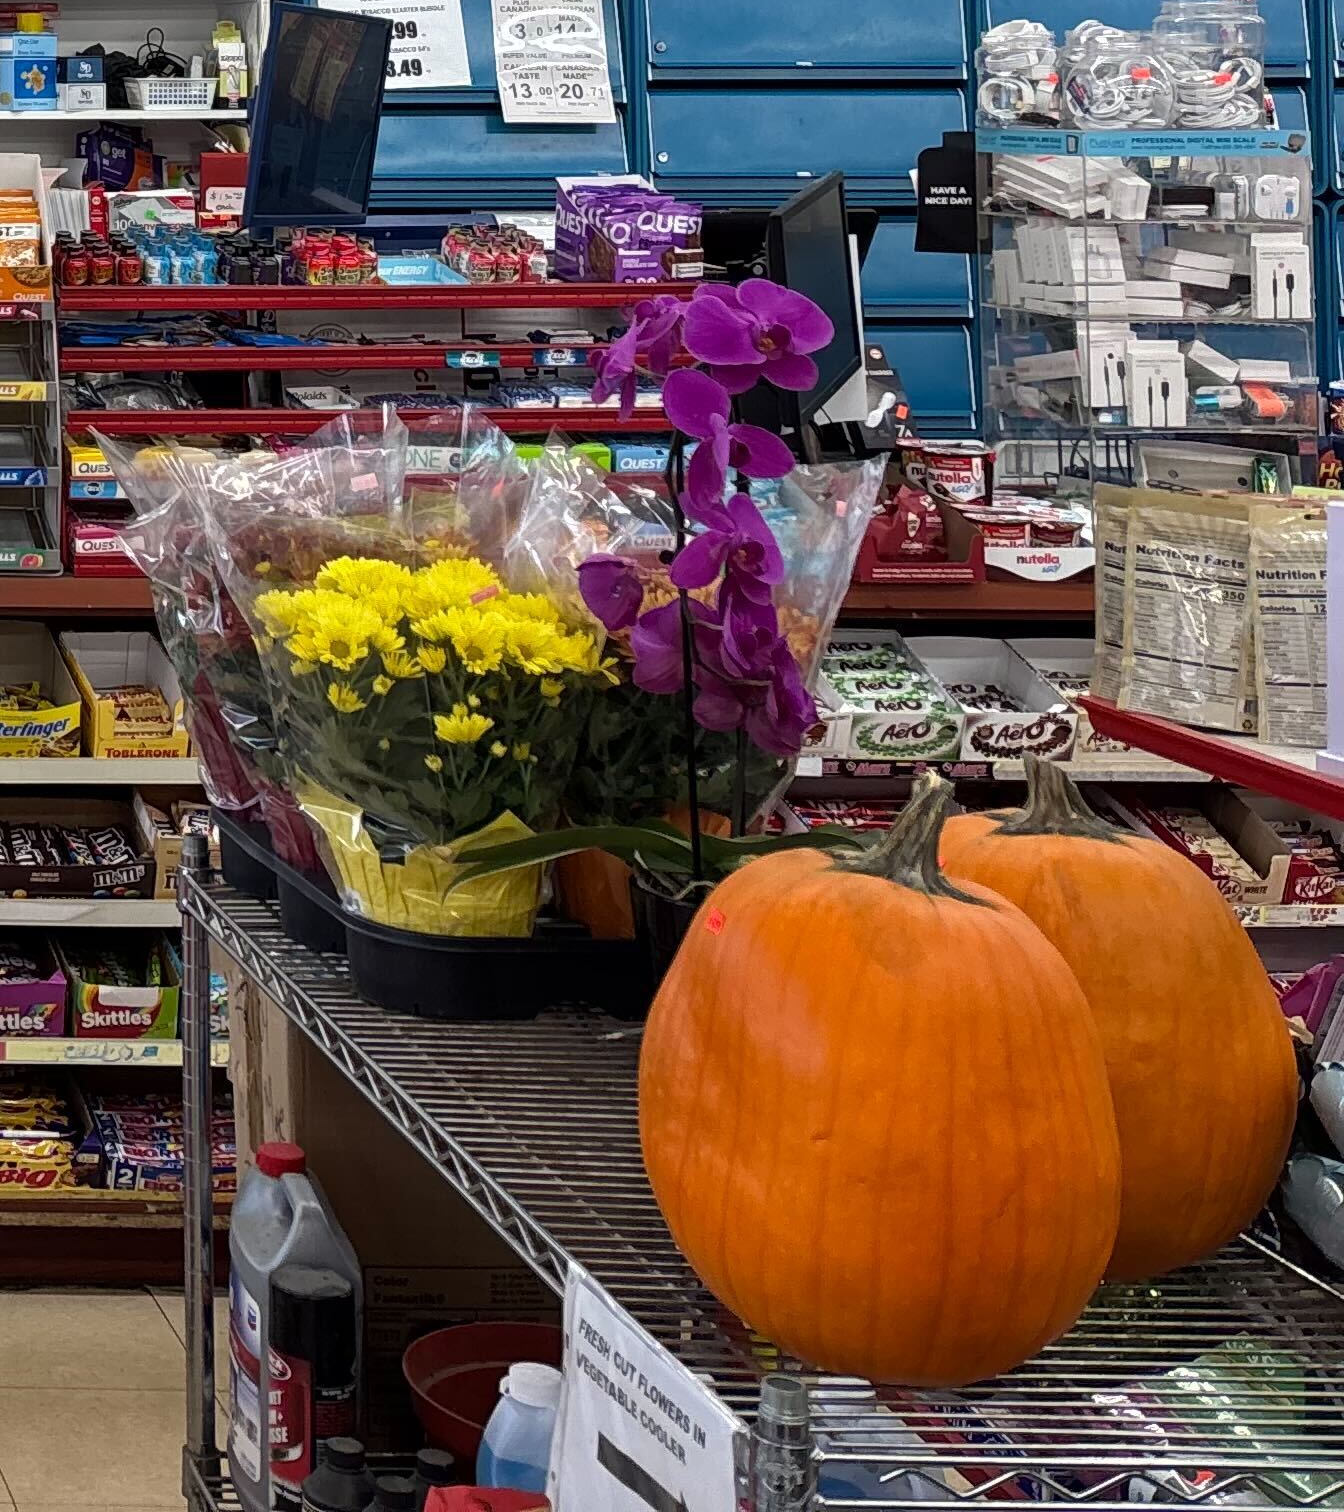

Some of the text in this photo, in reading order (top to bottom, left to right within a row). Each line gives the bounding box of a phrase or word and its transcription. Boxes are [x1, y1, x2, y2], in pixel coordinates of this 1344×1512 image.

[514, 72, 540, 80] TASTE
[930, 186, 966, 195] HAVE A
[925, 196, 972, 206] NICE DAY!
[556, 204, 587, 237] QUEST
[637, 210, 702, 234] QUEST
[393, 265, 429, 276] ENERGY
[13, 293, 46, 301] QUEST
[79, 463, 111, 473] QUES
[928, 471, 971, 483] nutella
[1017, 553, 1060, 565] nutella
[1204, 552, 1246, 569] Facts
[1256, 570, 1318, 580] Nutrition
[104, 748, 179, 758] TOBLERONE
[93, 866, 145, 887] m&m's
[1299, 876, 1333, 896] KitKat
[82, 1011, 152, 1028] Skittles
[117, 1167, 134, 1184] 2
[577, 1316, 709, 1449] FRESH CUT FLOWERS IN
[574, 1355, 689, 1466] VEGETABLE COOLER
